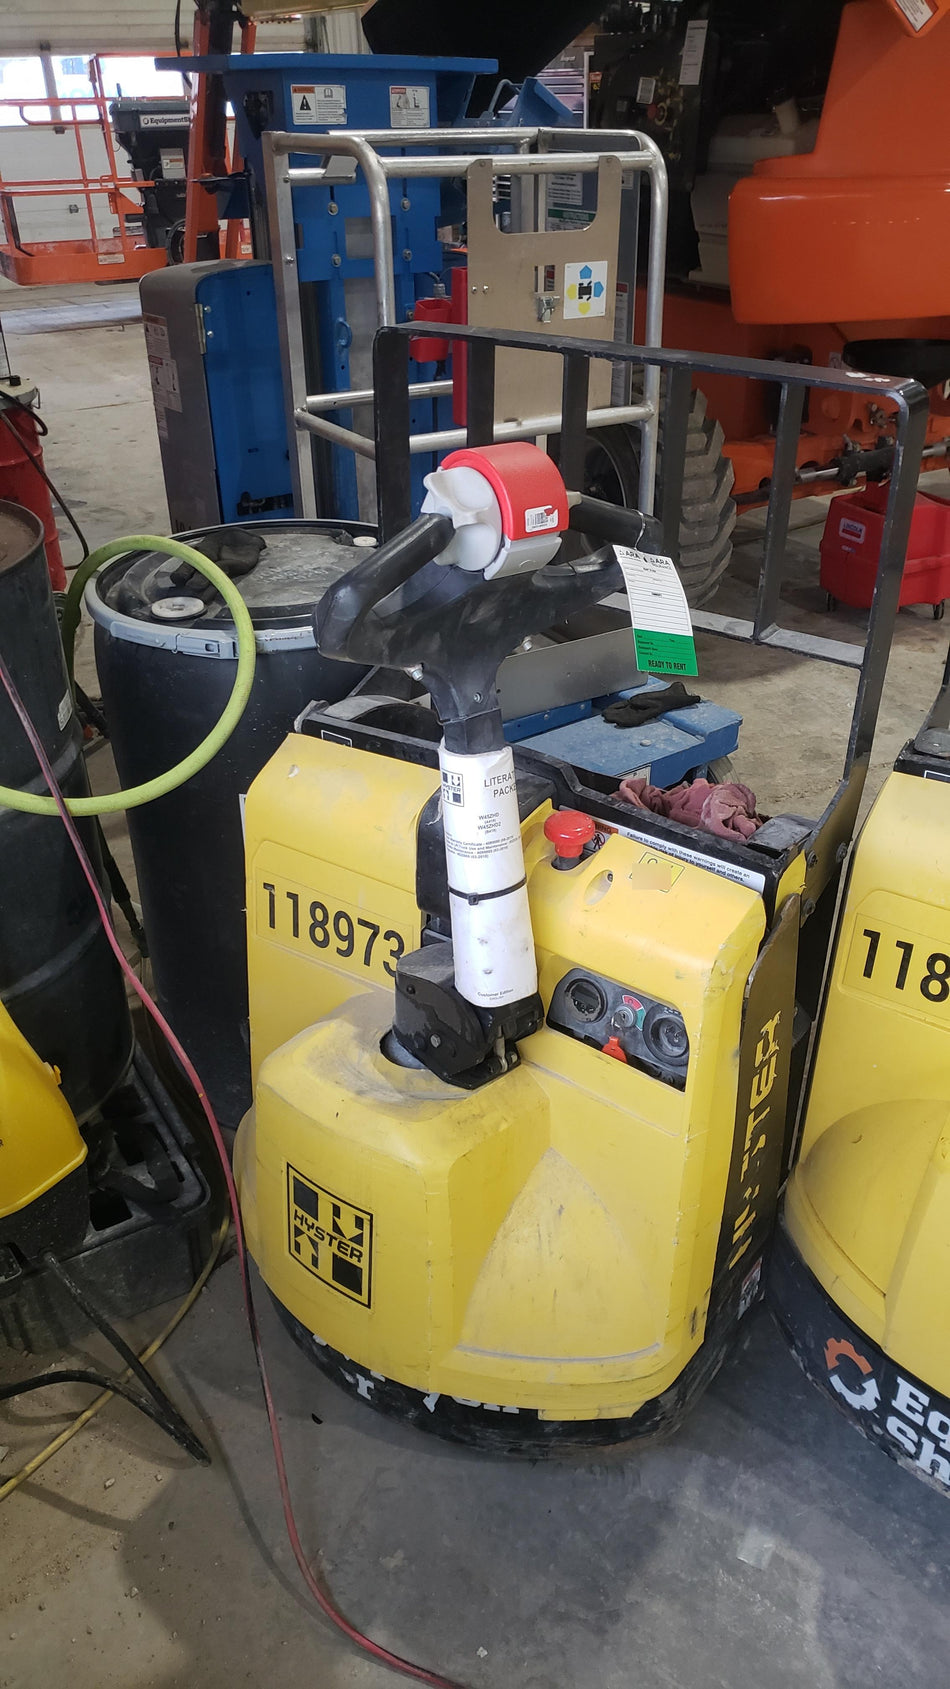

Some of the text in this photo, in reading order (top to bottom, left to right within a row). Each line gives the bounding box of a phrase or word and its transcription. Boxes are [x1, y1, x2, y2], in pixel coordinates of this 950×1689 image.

[150, 116, 191, 125] EquipmentS
[648, 659, 687, 671] READY TO RENT
[626, 831, 643, 843] Failure
[649, 840, 667, 851] comply
[667, 845, 679, 853] with
[678, 848, 693, 859] these
[693, 854, 716, 867] warnings
[716, 861, 727, 870] will
[726, 866, 743, 876] create
[716, 867, 727, 876] and
[262, 881, 406, 978] 118973
[862, 928, 950, 1003] 118
[293, 1208, 364, 1264] HYSTER
